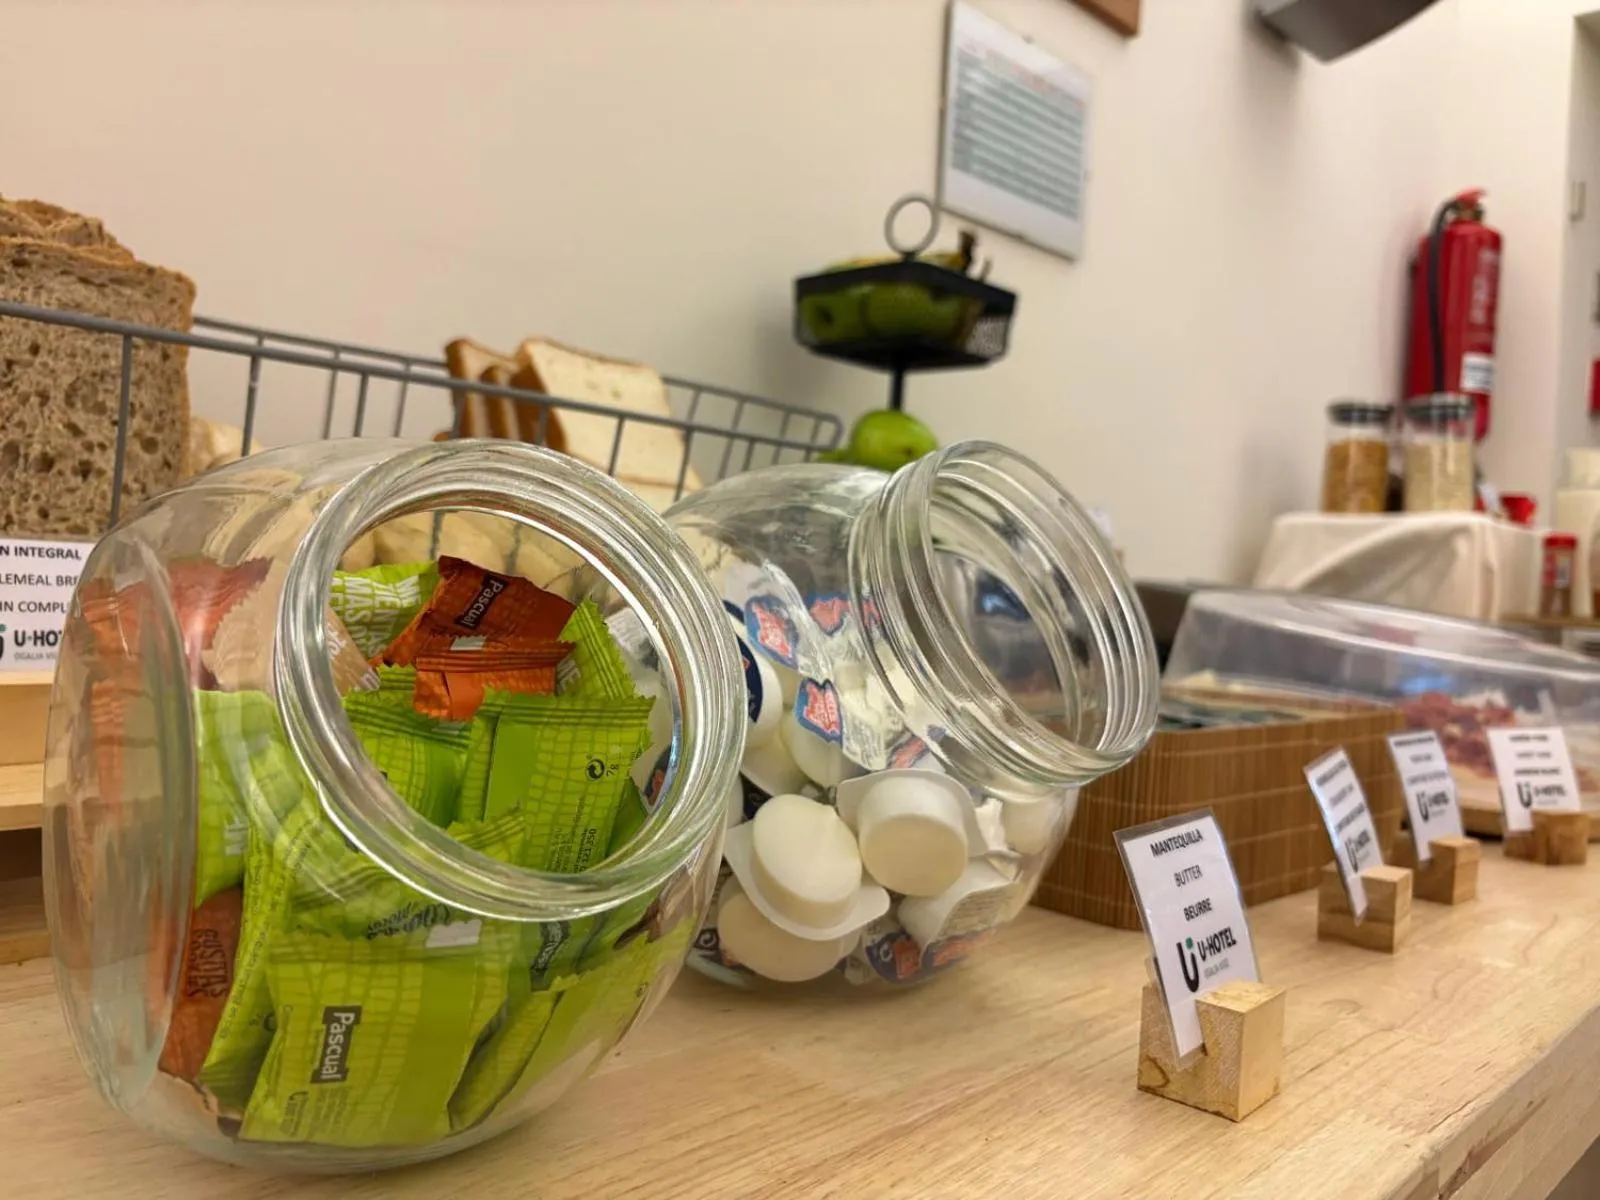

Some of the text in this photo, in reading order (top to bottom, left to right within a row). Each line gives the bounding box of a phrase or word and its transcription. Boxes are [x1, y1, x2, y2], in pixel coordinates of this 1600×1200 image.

[14, 545, 82, 560] INTEGRAL
[0, 573, 52, 586] LEMEAL
[18, 600, 68, 614] COMPL
[460, 579, 504, 626] Pascual
[1150, 829, 1203, 857] MANTEQUILLA
[1174, 864, 1203, 887] BUTTER
[1183, 898, 1212, 921] BEURRE
[1197, 927, 1237, 961] U-HOTEL
[320, 1012, 356, 1080] Pascual
